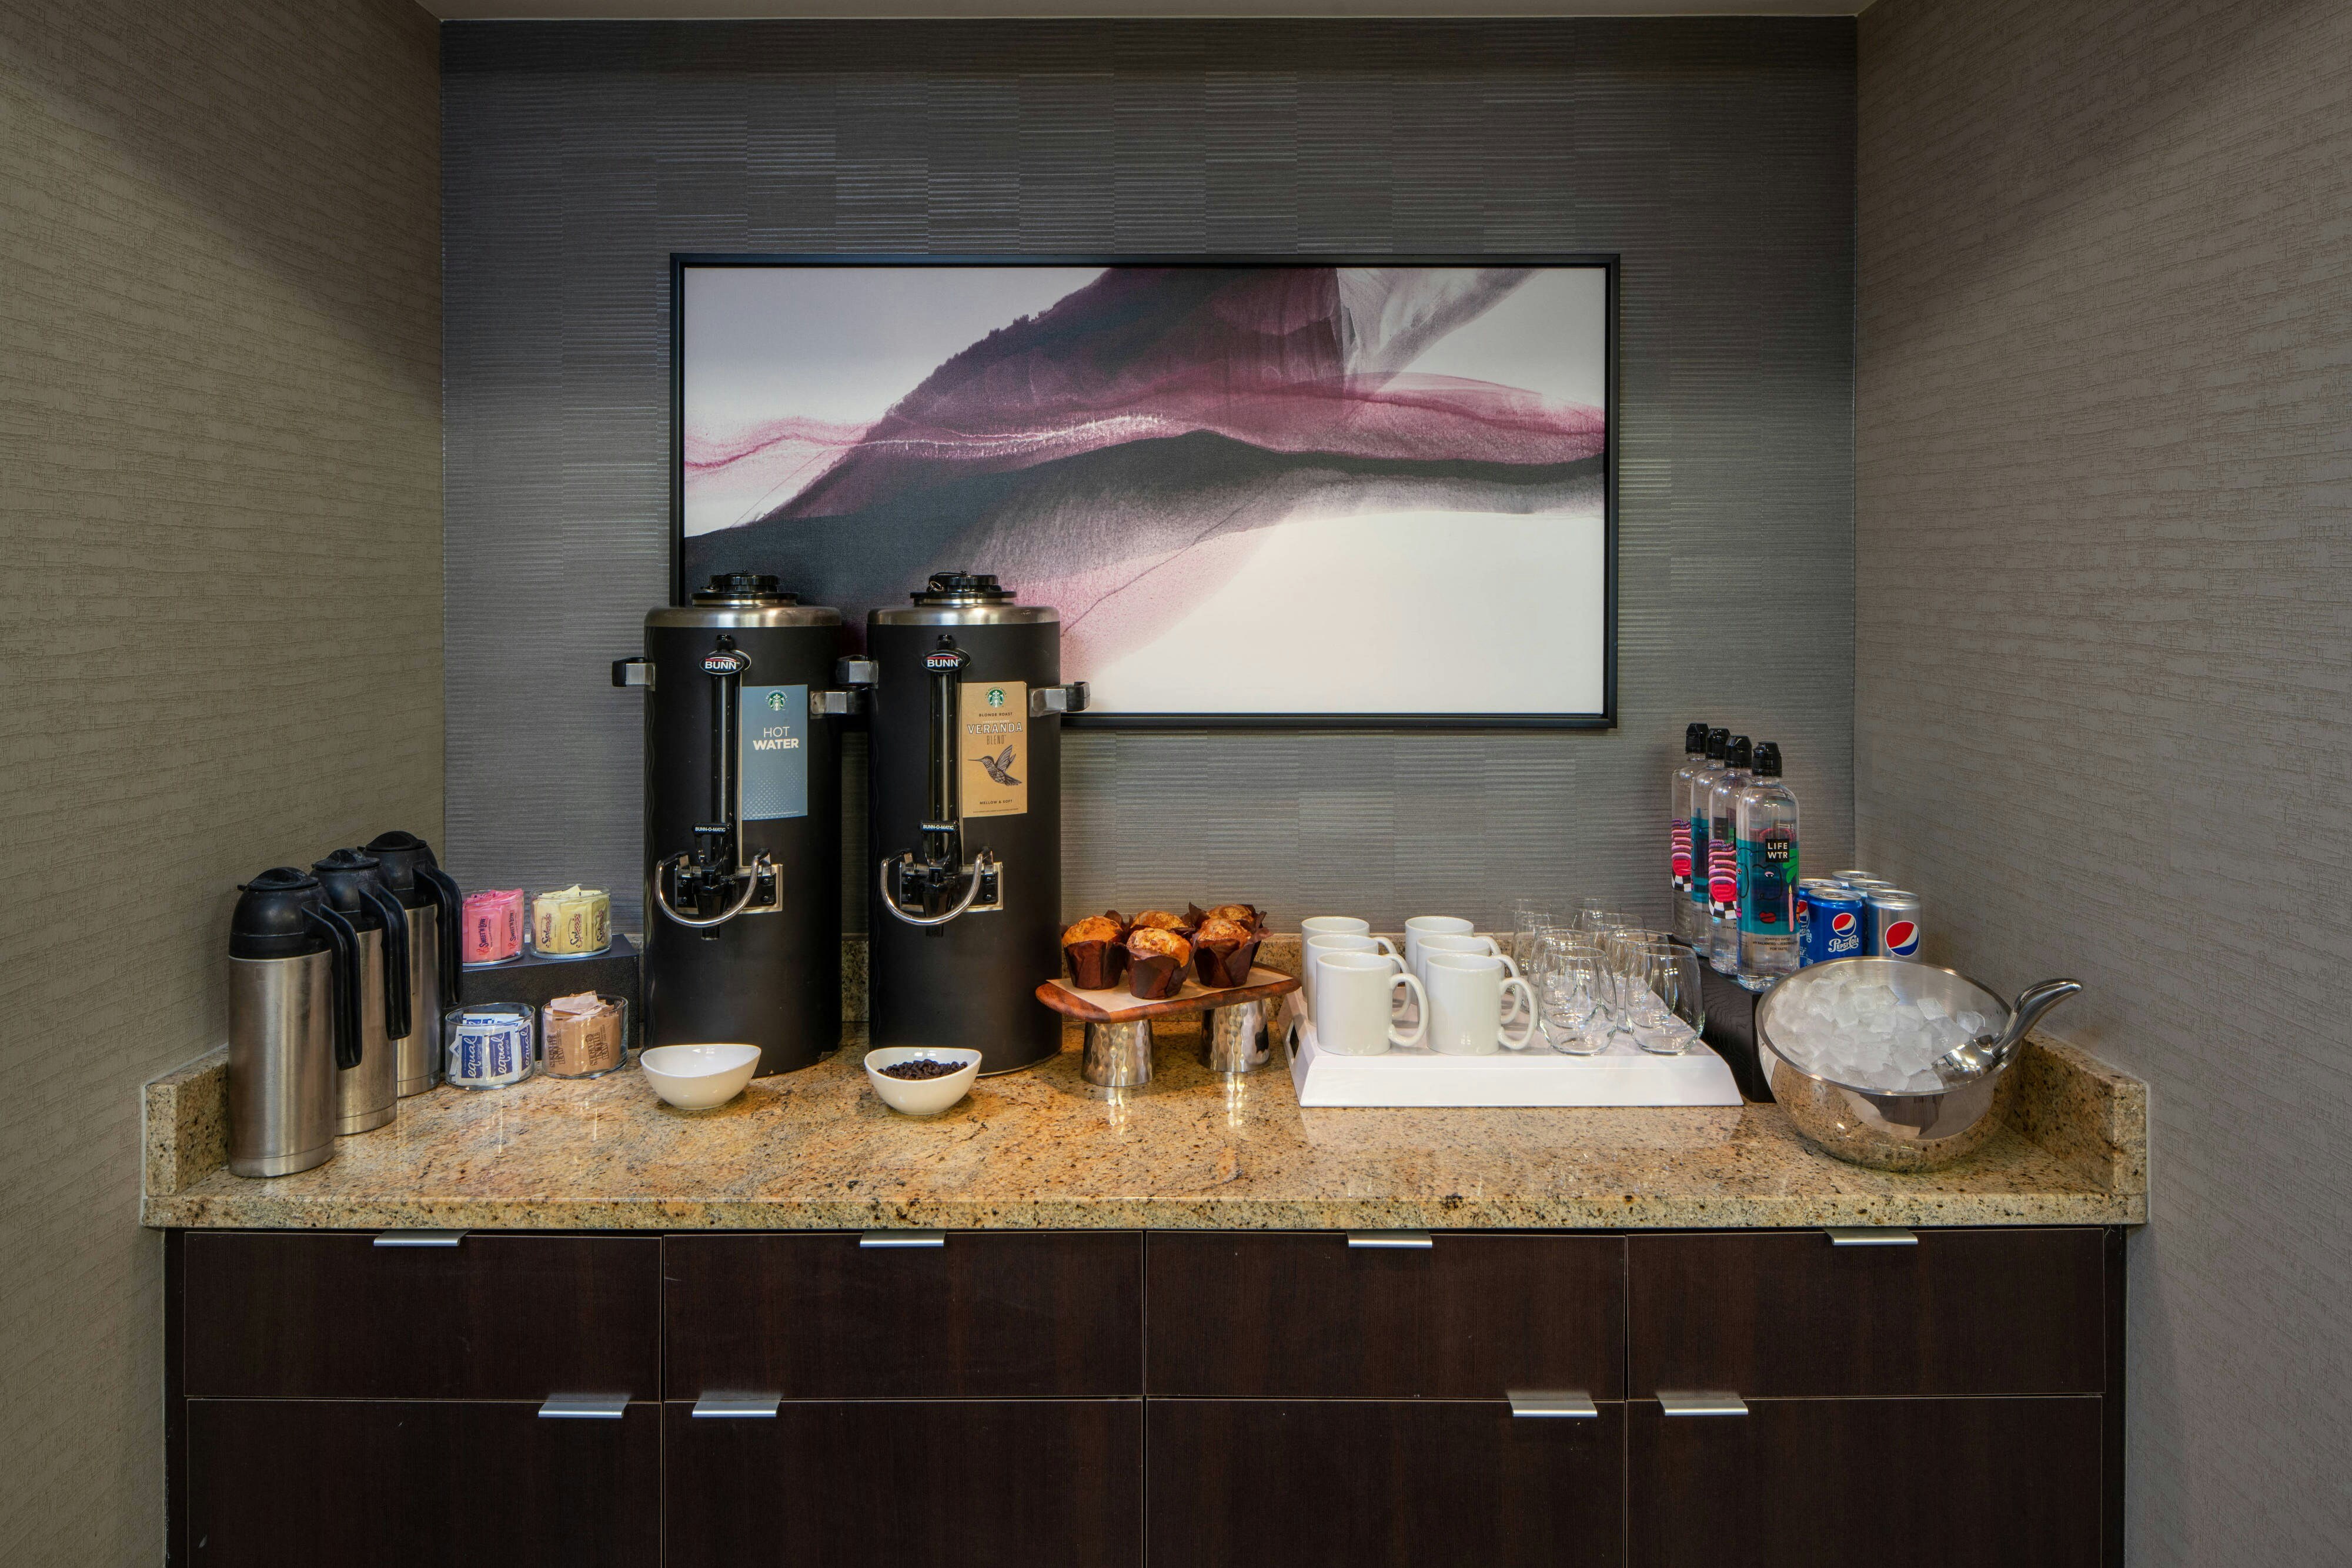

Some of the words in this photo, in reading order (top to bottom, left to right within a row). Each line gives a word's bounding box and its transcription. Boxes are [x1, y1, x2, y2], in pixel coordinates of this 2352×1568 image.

[705, 661, 737, 670] BUNN
[927, 659, 958, 667] BUNN
[763, 726, 790, 738] HOT
[967, 721, 1023, 734] VERANDA
[752, 738, 800, 751] WATER
[987, 735, 1005, 745] BLEND
[1768, 842, 1788, 850] LIFE
[464, 1036, 481, 1079] equal
[491, 1032, 511, 1074] equal
[601, 1043, 610, 1060] RAW
